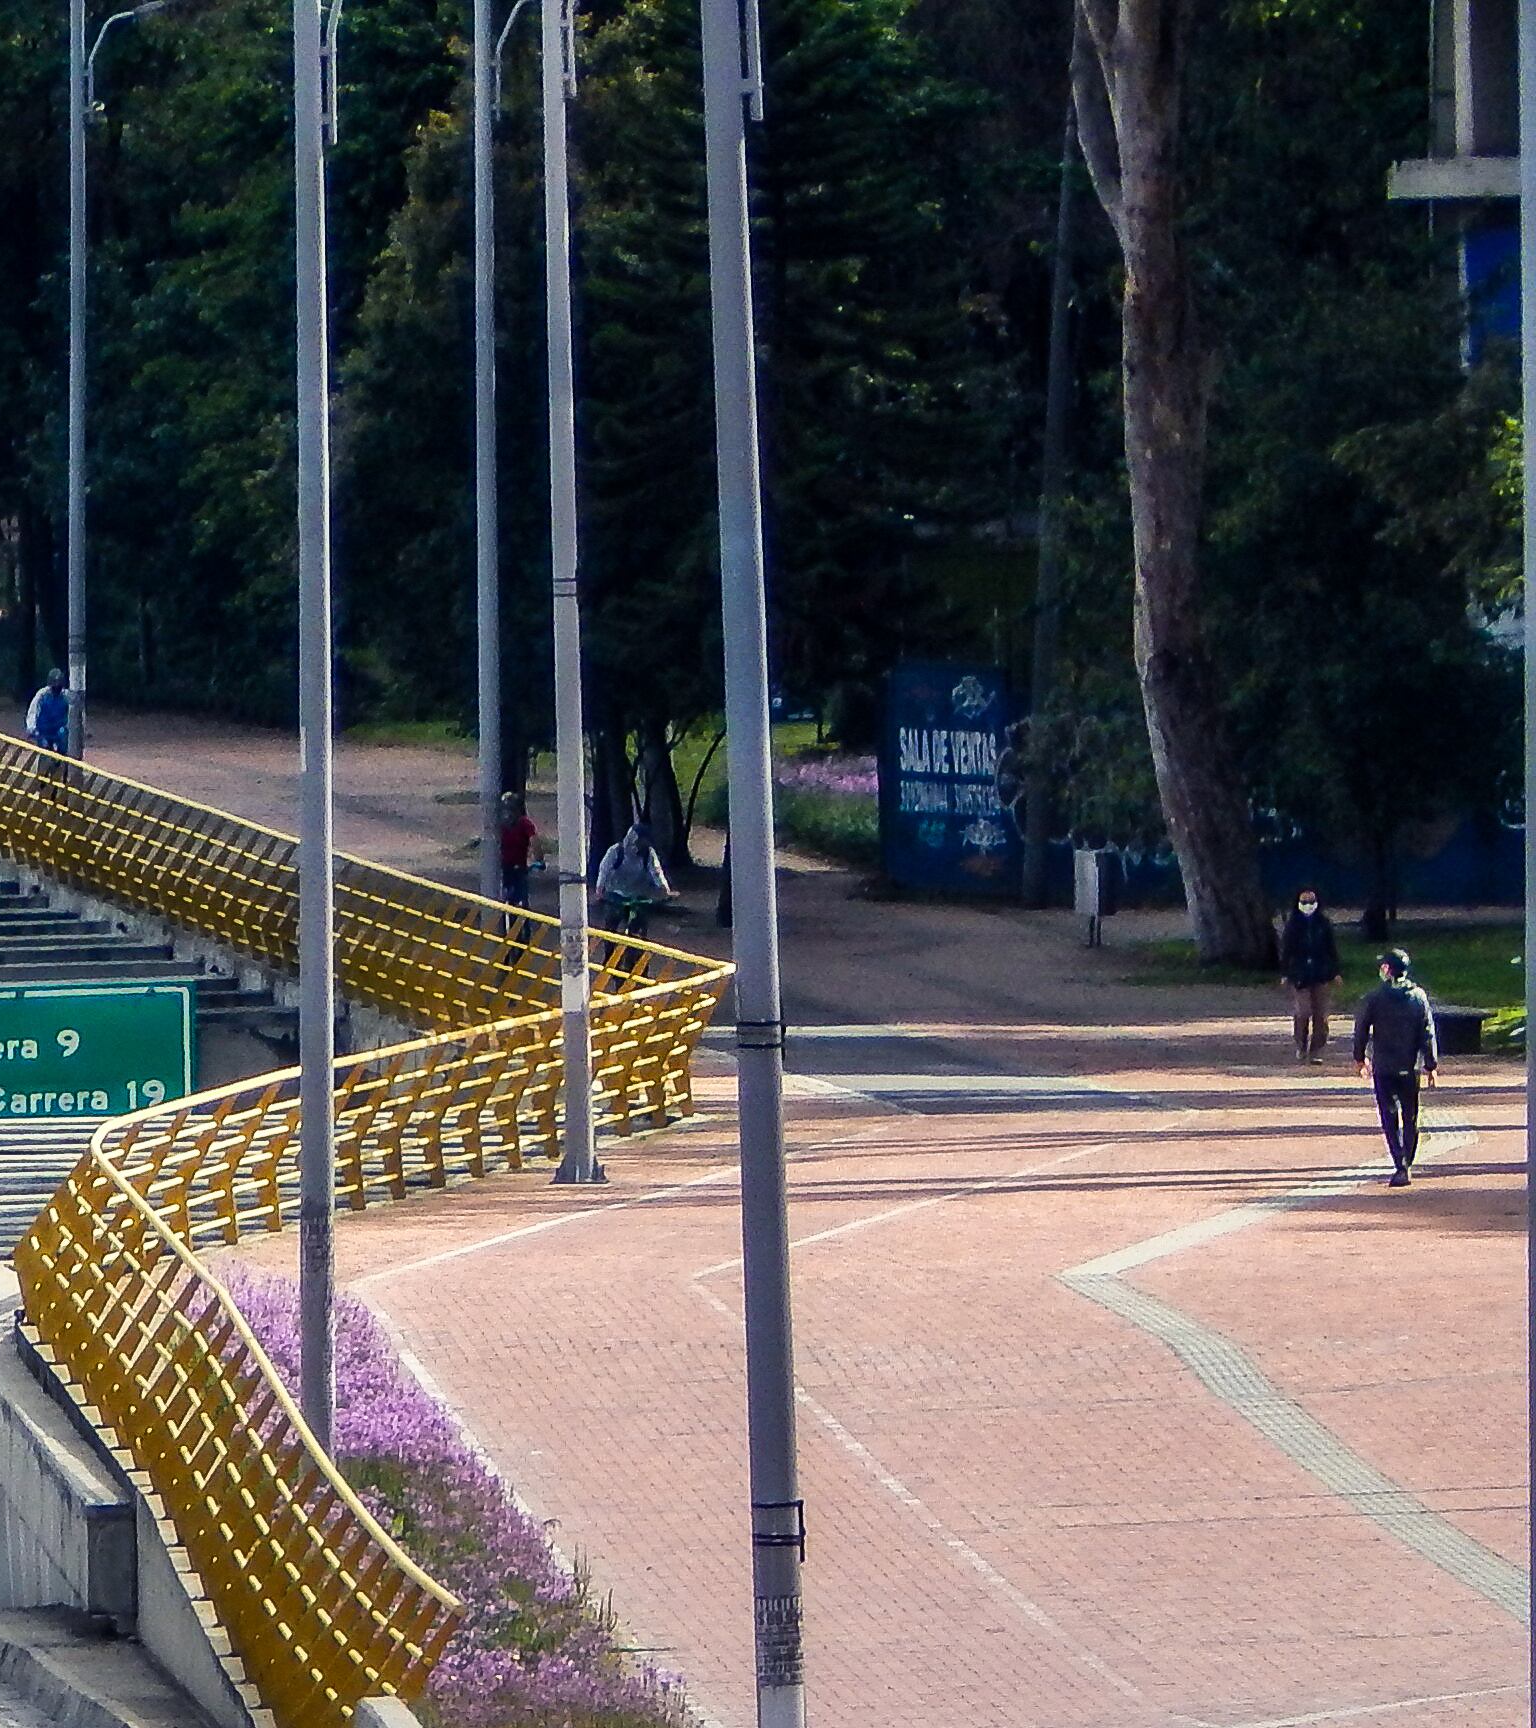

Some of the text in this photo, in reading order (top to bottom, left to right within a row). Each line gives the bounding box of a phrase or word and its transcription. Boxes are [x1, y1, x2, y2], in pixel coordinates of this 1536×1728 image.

[899, 727, 996, 777] SALA DE VENTAS
[56, 1029, 81, 1058] 9
[125, 1079, 166, 1110] 19
